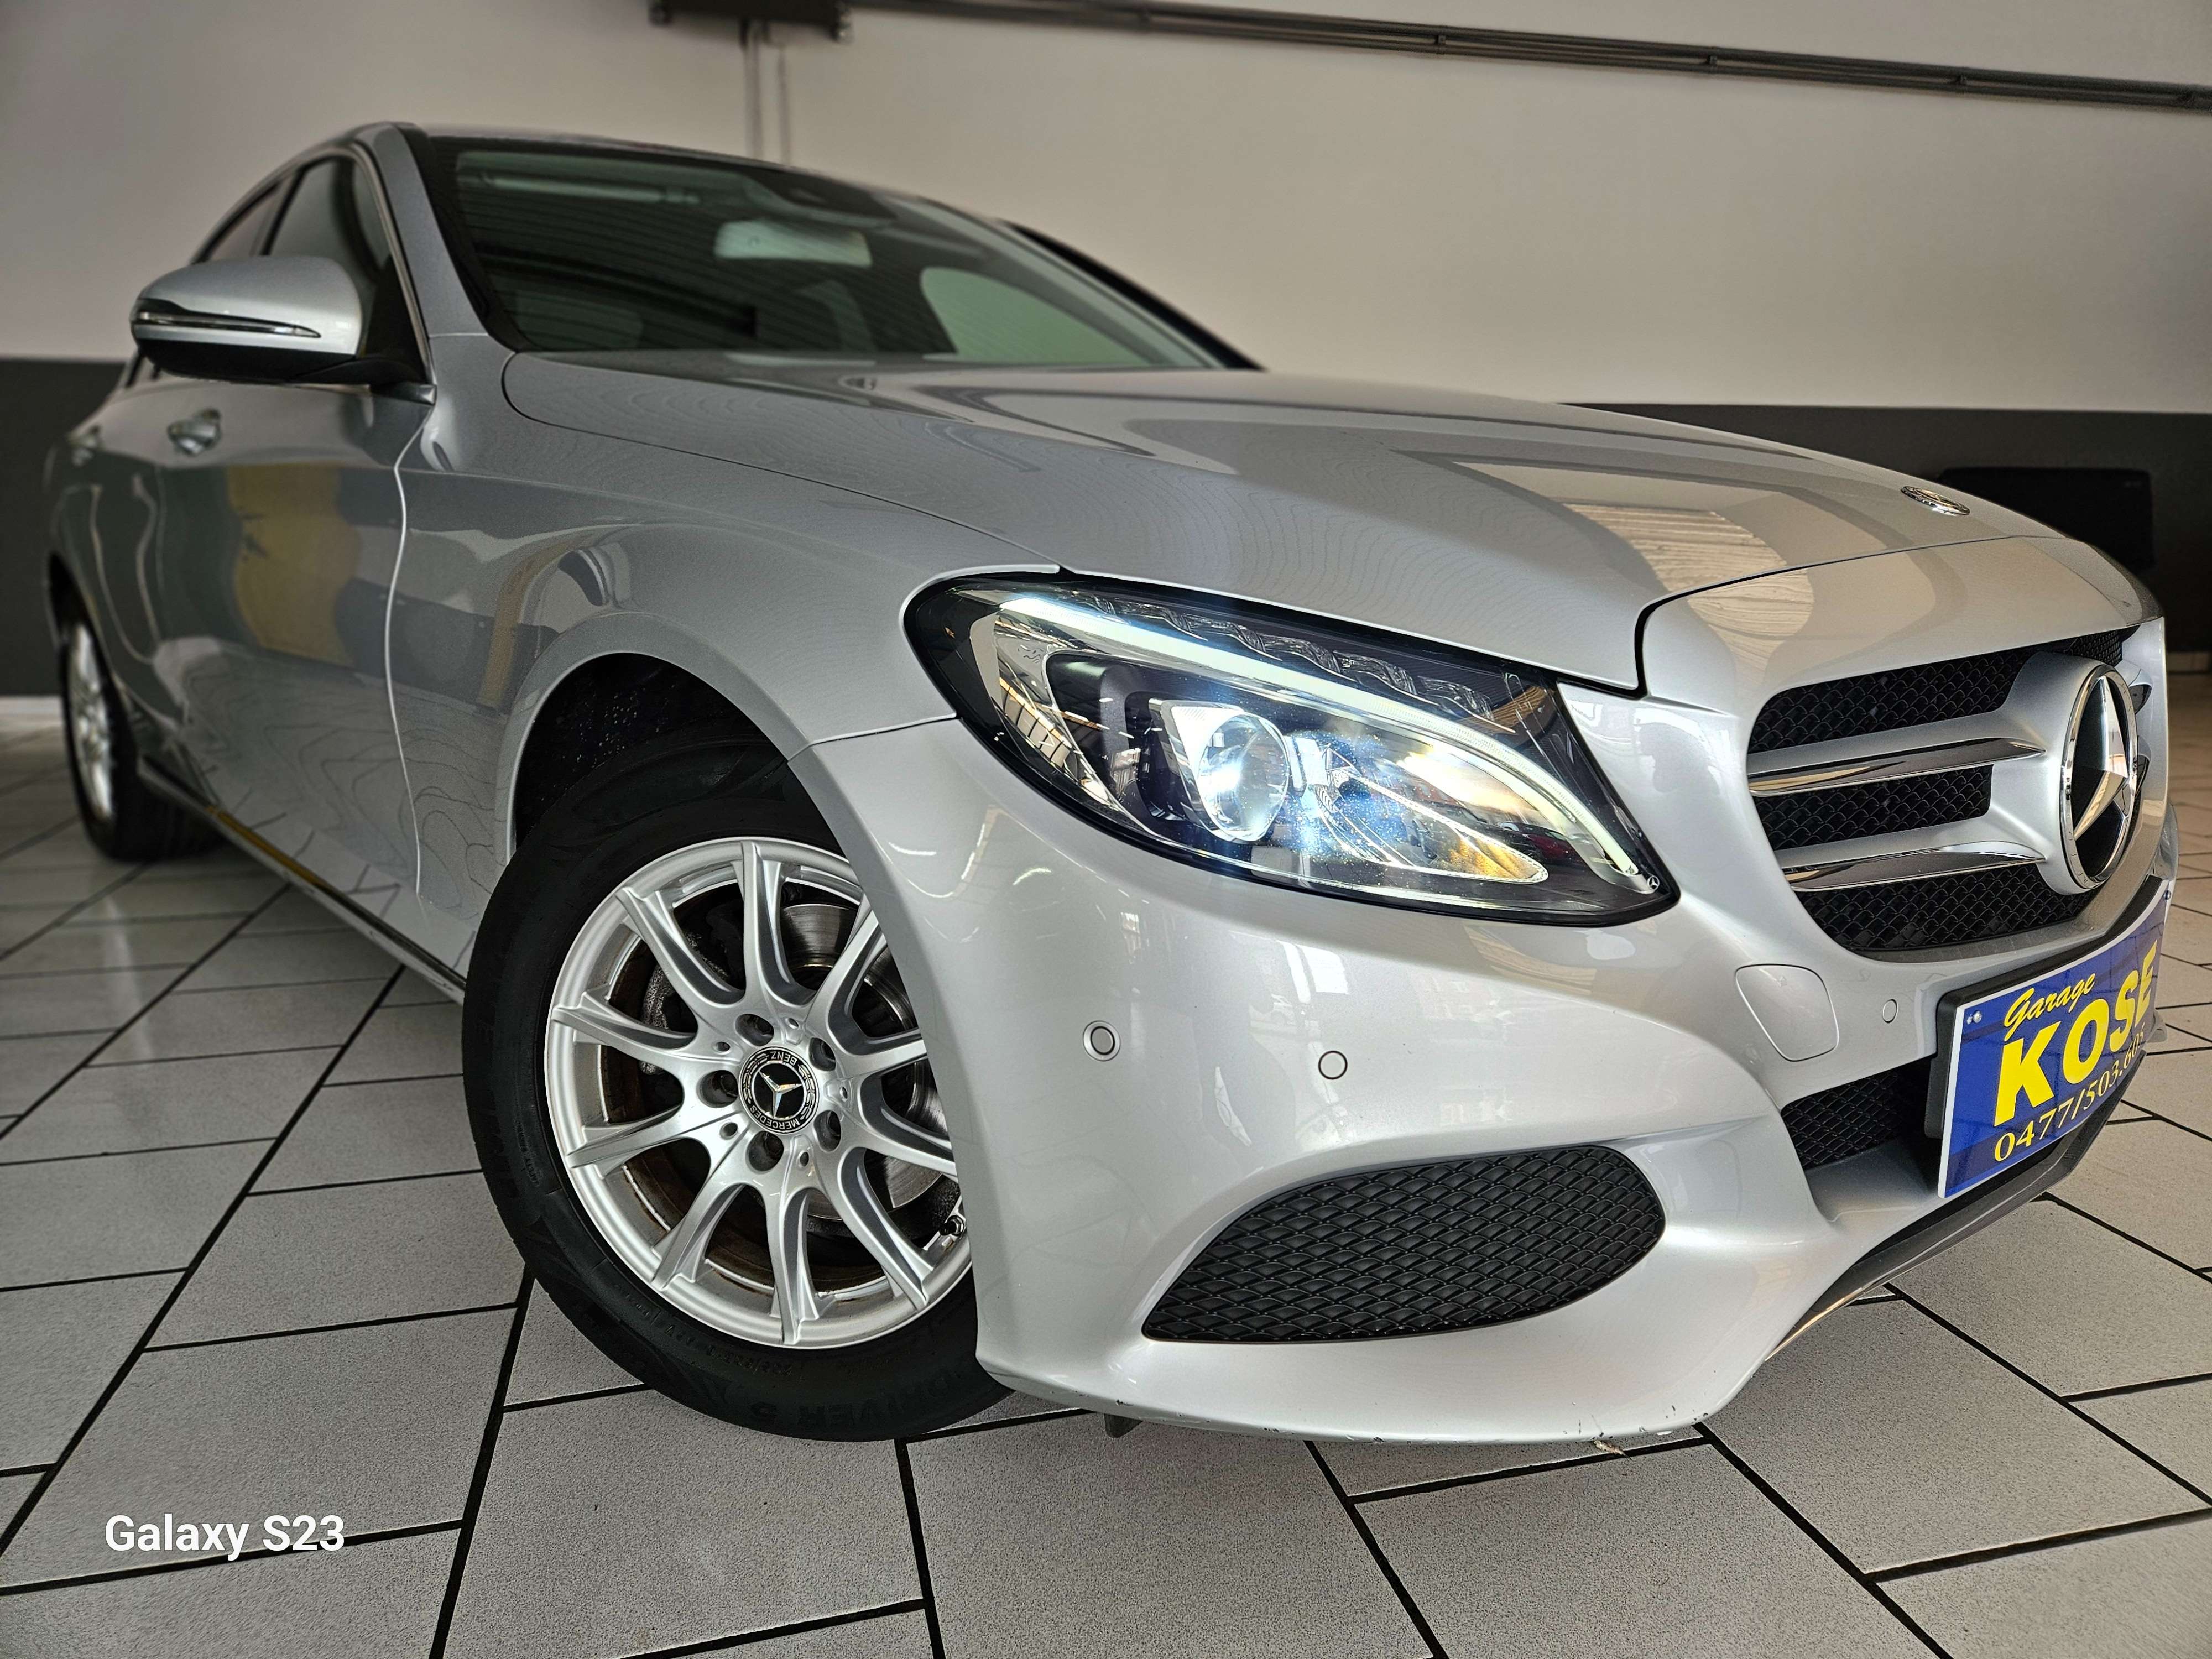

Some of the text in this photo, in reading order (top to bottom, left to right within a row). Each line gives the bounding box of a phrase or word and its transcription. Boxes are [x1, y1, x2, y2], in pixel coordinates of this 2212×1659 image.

[2003, 972, 2096, 1042] Garage
[1994, 938, 2158, 1128] KOSE
[770, 1051, 798, 1065] BENZ
[749, 1105, 801, 1130] MERCEDES
